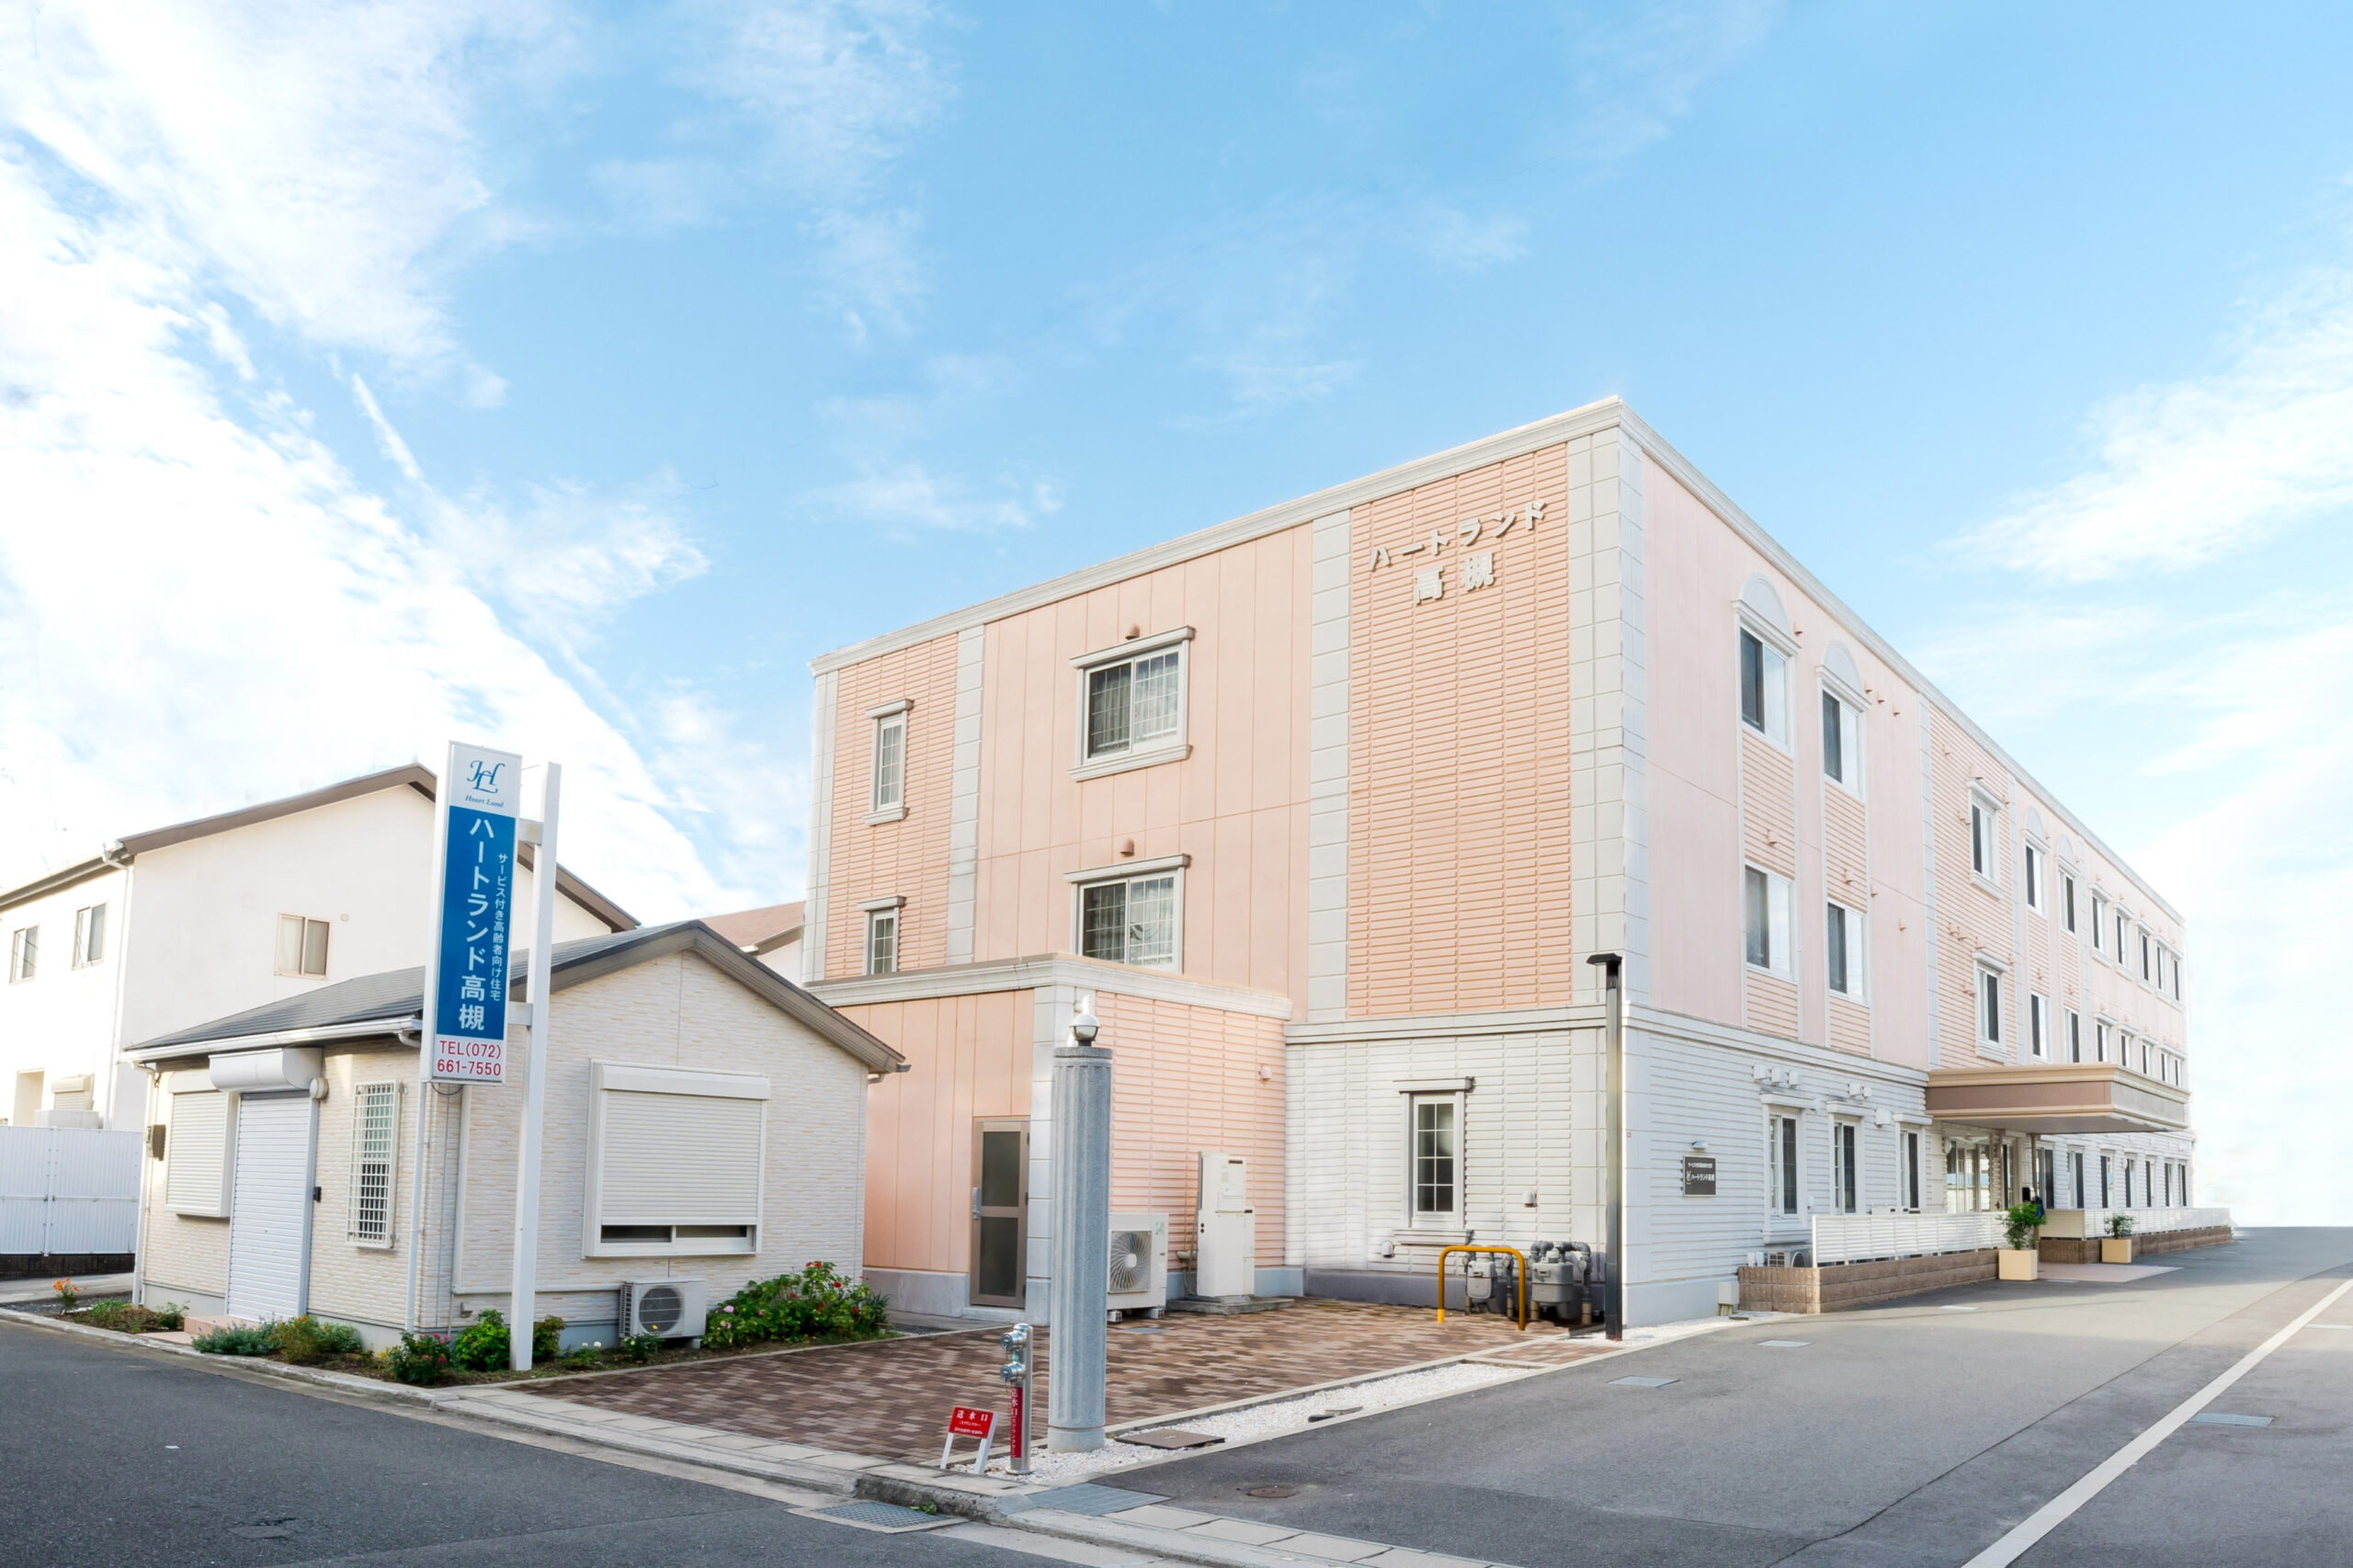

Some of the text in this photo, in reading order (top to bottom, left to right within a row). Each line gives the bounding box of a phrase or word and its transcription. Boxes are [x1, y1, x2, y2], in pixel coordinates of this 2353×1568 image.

[1368, 498, 1546, 572] ハートランド
[465, 795, 505, 808] Heart Land
[459, 818, 494, 1031] ハートランド高槻
[489, 853, 508, 1002] サービス付き高齢者向け住宅
[437, 1059, 502, 1076] 661-7550
